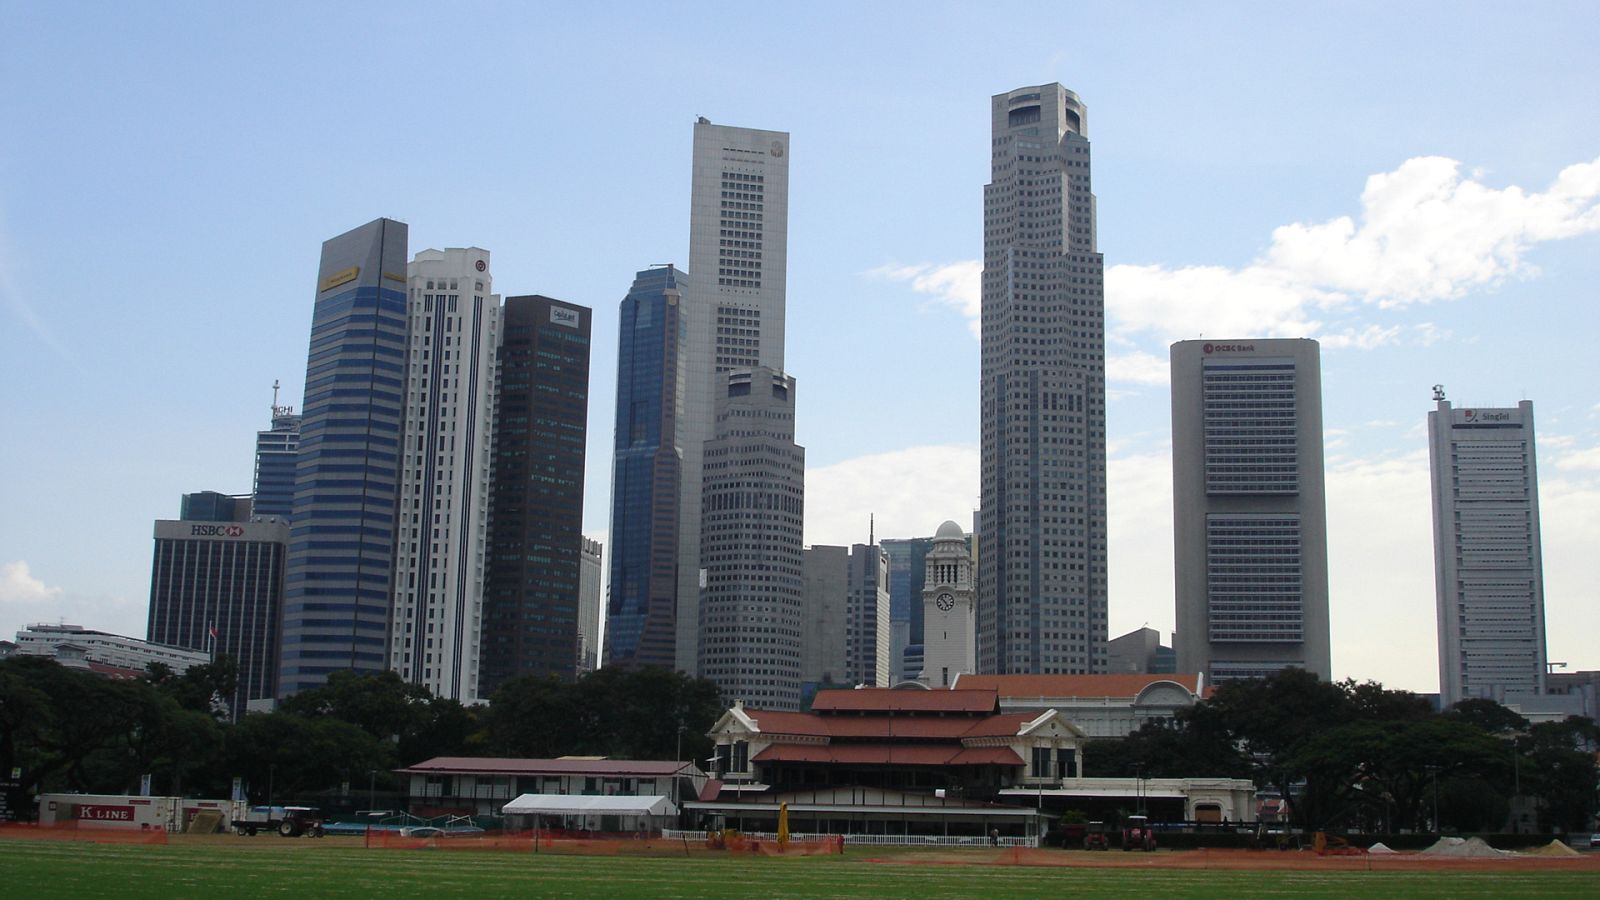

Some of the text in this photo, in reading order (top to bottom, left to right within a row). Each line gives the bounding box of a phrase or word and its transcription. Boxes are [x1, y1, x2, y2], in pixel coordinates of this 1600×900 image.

[1482, 412, 1510, 421] SingTel
[191, 524, 225, 536] HSBC
[81, 806, 129, 819] K LINE
